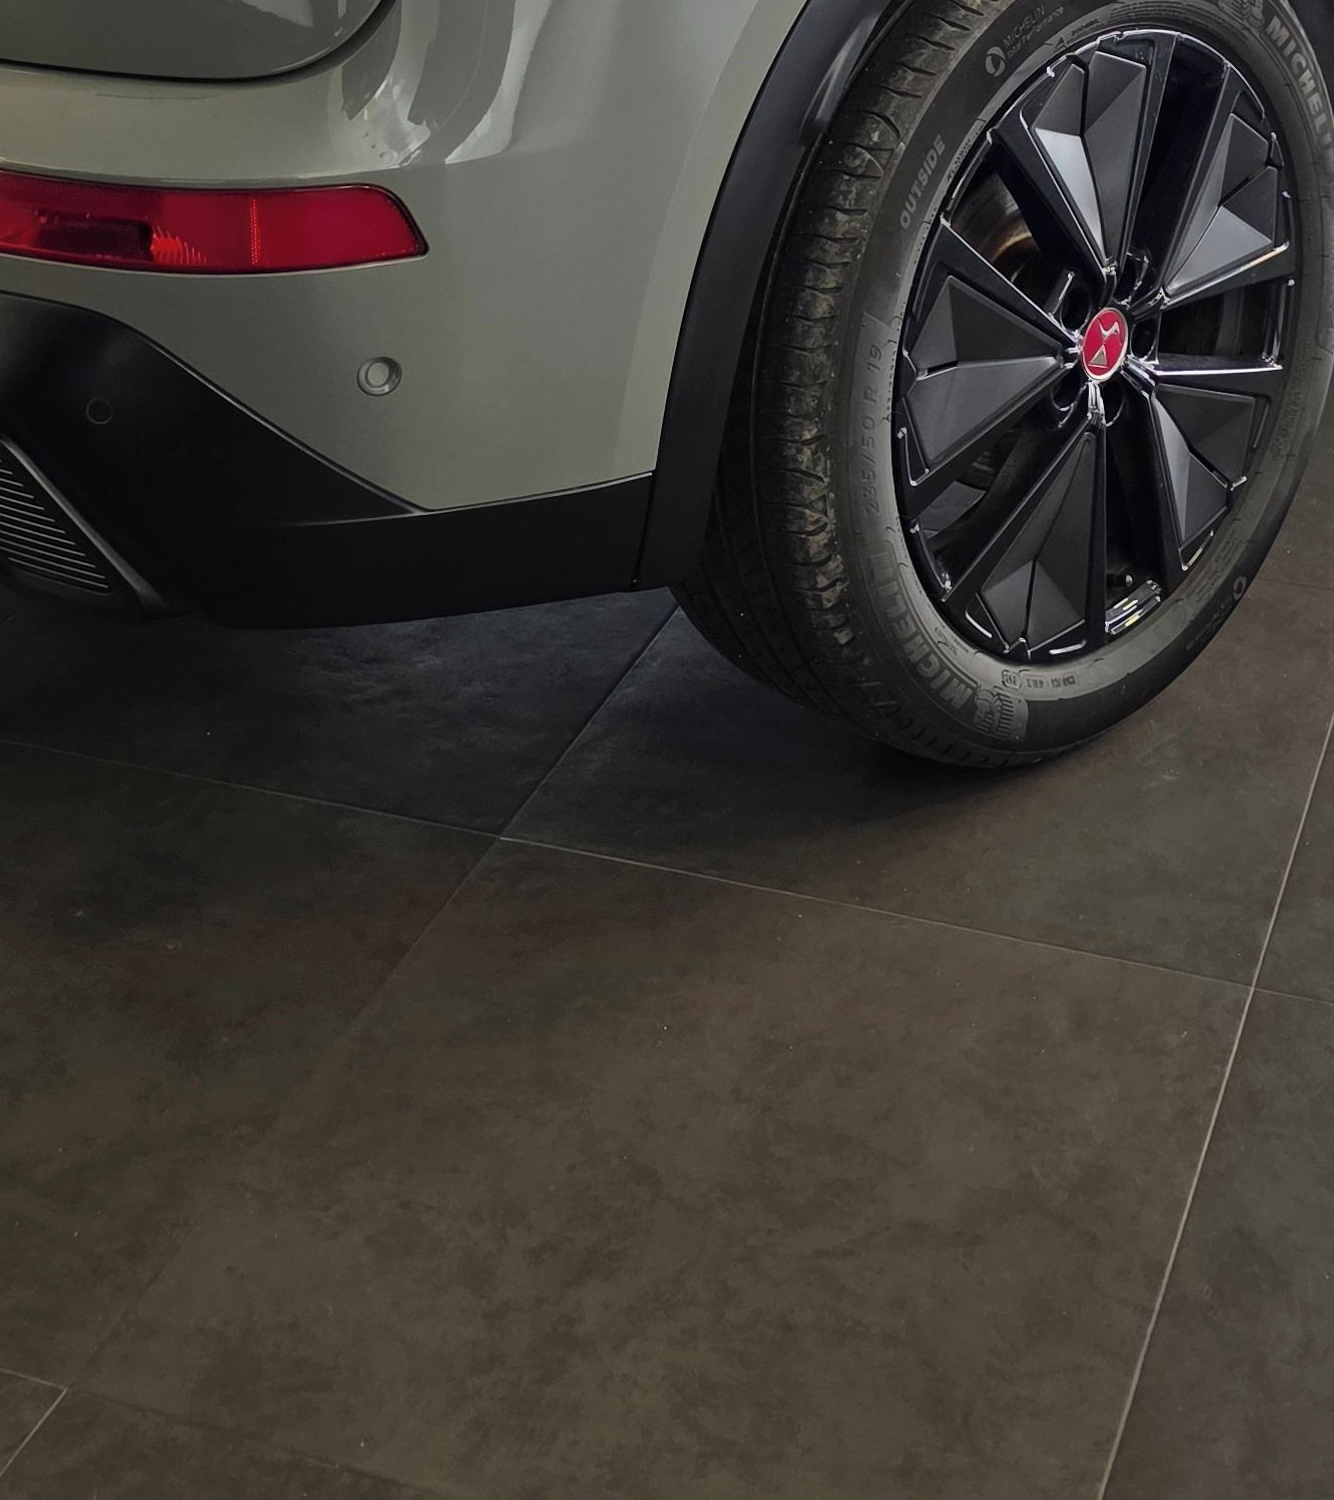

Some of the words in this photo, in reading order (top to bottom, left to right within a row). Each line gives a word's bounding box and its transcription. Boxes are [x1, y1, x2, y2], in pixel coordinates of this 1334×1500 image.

[1003, 4, 1046, 48] MICHELIN
[900, 134, 945, 230] OUTSIDE
[866, 343, 883, 372] 19
